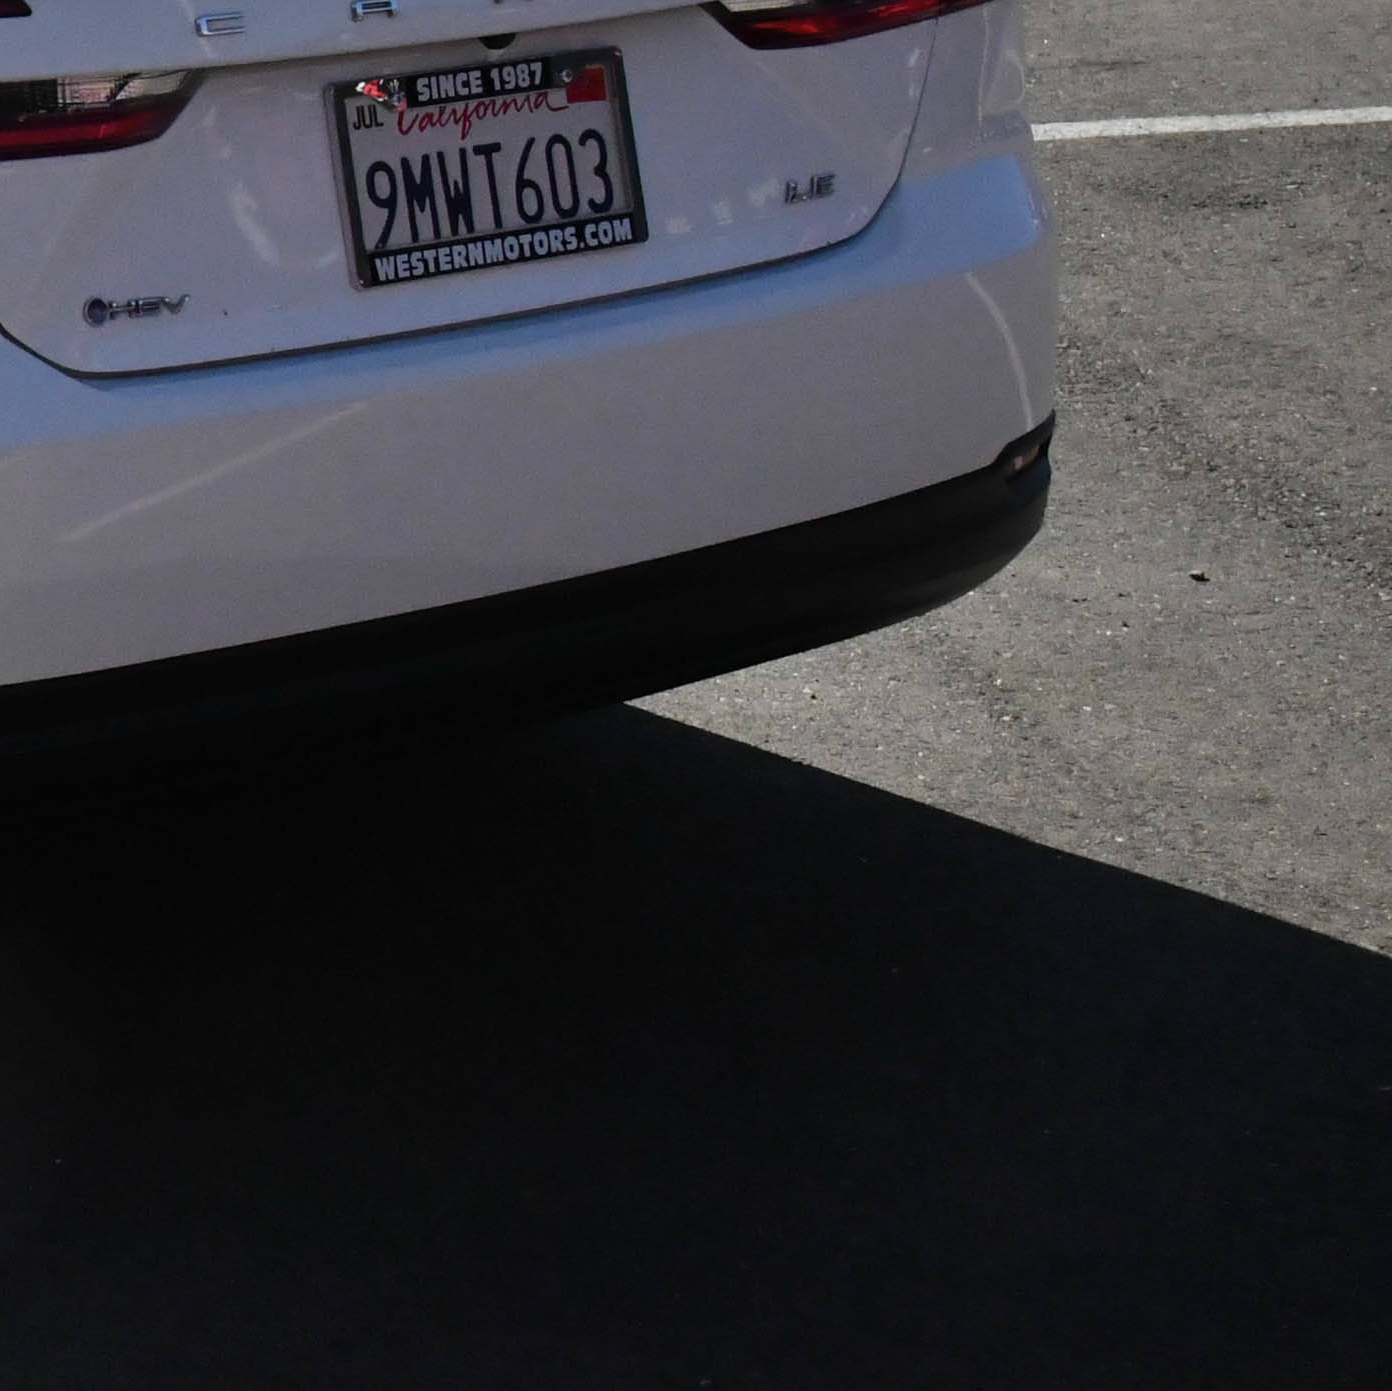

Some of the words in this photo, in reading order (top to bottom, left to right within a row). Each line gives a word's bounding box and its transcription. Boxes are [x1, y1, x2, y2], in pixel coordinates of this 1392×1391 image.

[417, 70, 483, 102] SINCE
[490, 62, 543, 90] 1987
[352, 104, 384, 130] JUL
[397, 91, 570, 141] California
[365, 128, 615, 250] 9MWT603
[374, 217, 633, 282] WESTERNMOTORS.COM
